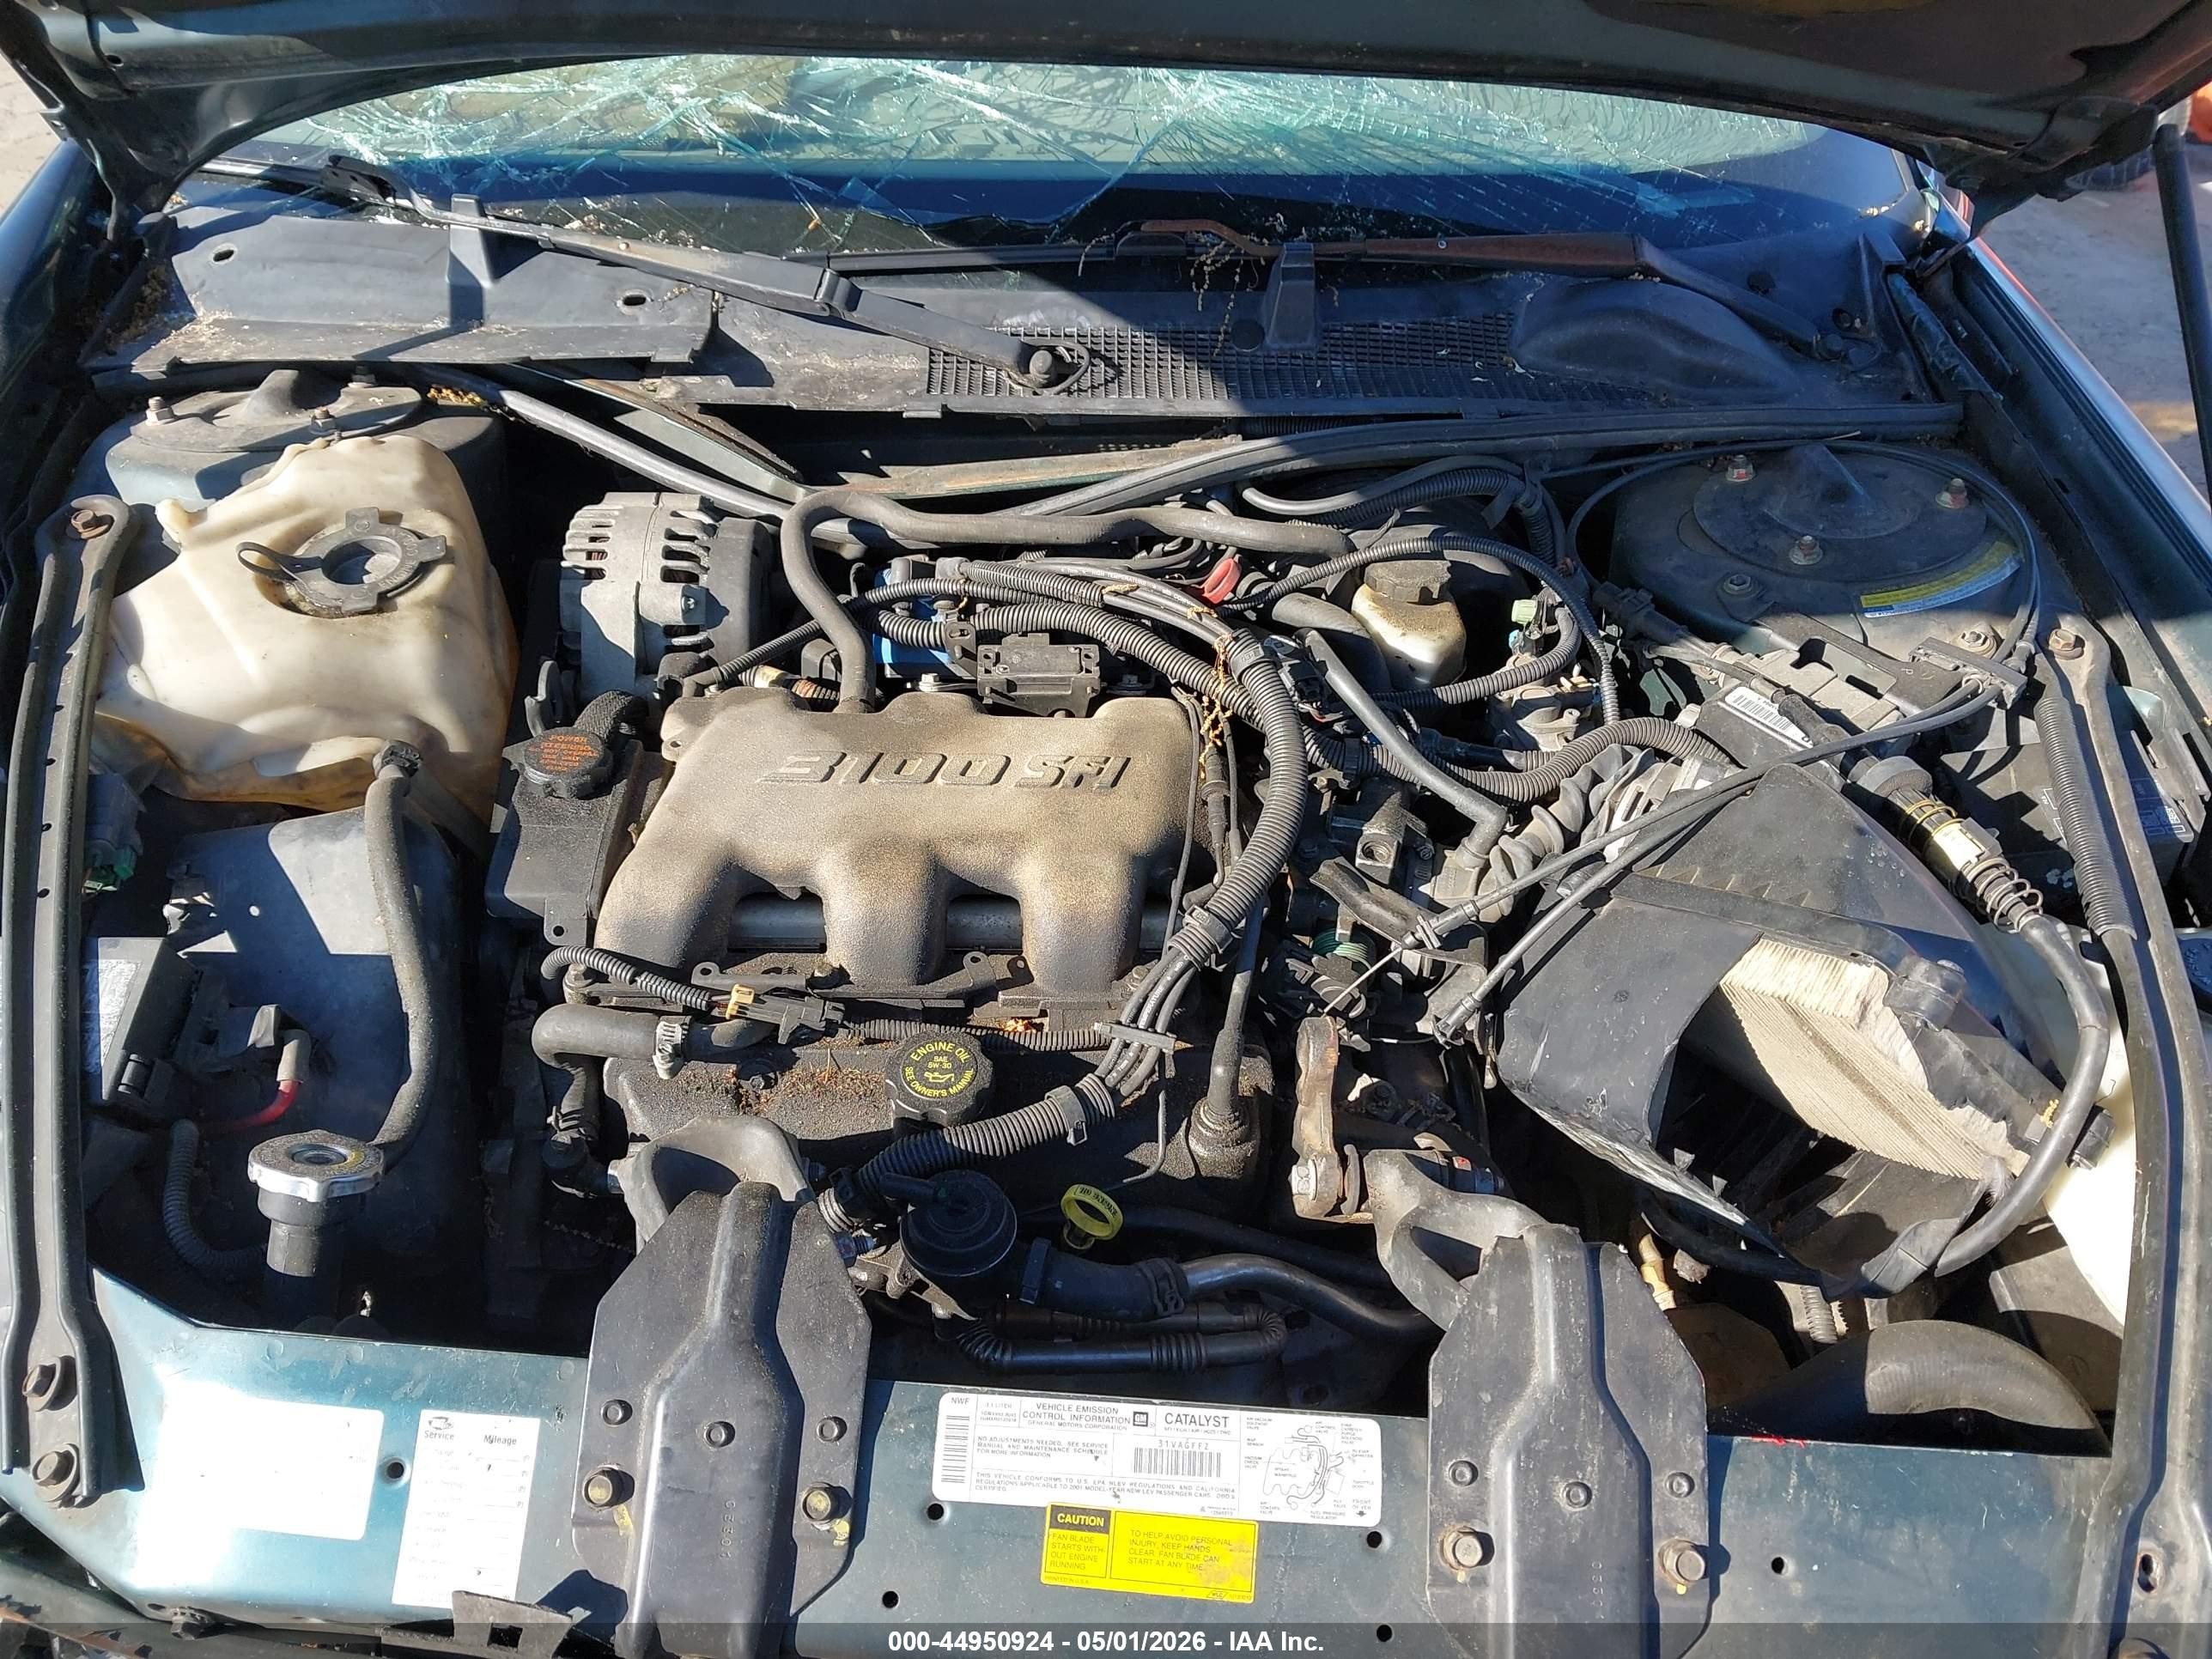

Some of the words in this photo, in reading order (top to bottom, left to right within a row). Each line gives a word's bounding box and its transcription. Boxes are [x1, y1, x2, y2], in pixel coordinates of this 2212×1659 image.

[755, 750, 1011, 785] 3100
[1014, 753, 1132, 789] SFI
[910, 1042, 956, 1061] ENGINE
[955, 1048, 971, 1063] OIL
[904, 1066, 915, 1082] SEE
[910, 1080, 948, 1097] OWNER'S
[948, 1067, 974, 1096] MANUAL
[951, 1397, 969, 1406] NWF
[1036, 1403, 1074, 1413] VEHICLE
[1076, 1405, 1119, 1415] EMISSION
[1023, 1411, 1066, 1421] CONTROL
[1070, 1413, 1131, 1425] INFORMATION
[1164, 1413, 1230, 1428] CATALYST
[1085, 1423, 1127, 1431] CORPORATION
[424, 1430, 455, 1441] Service
[483, 1434, 518, 1446] Mileage
[1057, 1513, 1104, 1527] CAUTION
[1069, 1535, 1096, 1544] BLADE
[1164, 1533, 1189, 1541] AVOID
[1191, 1536, 1233, 1547] PERSONAL
[1051, 1542, 1082, 1552] STARTS
[1050, 1551, 1066, 1559] OUT
[1069, 1553, 1098, 1563] ENGINE
[1176, 1553, 1200, 1561] BLADE
[1049, 1560, 1086, 1571] RUNNING
[1168, 1560, 1183, 1569] ANY
